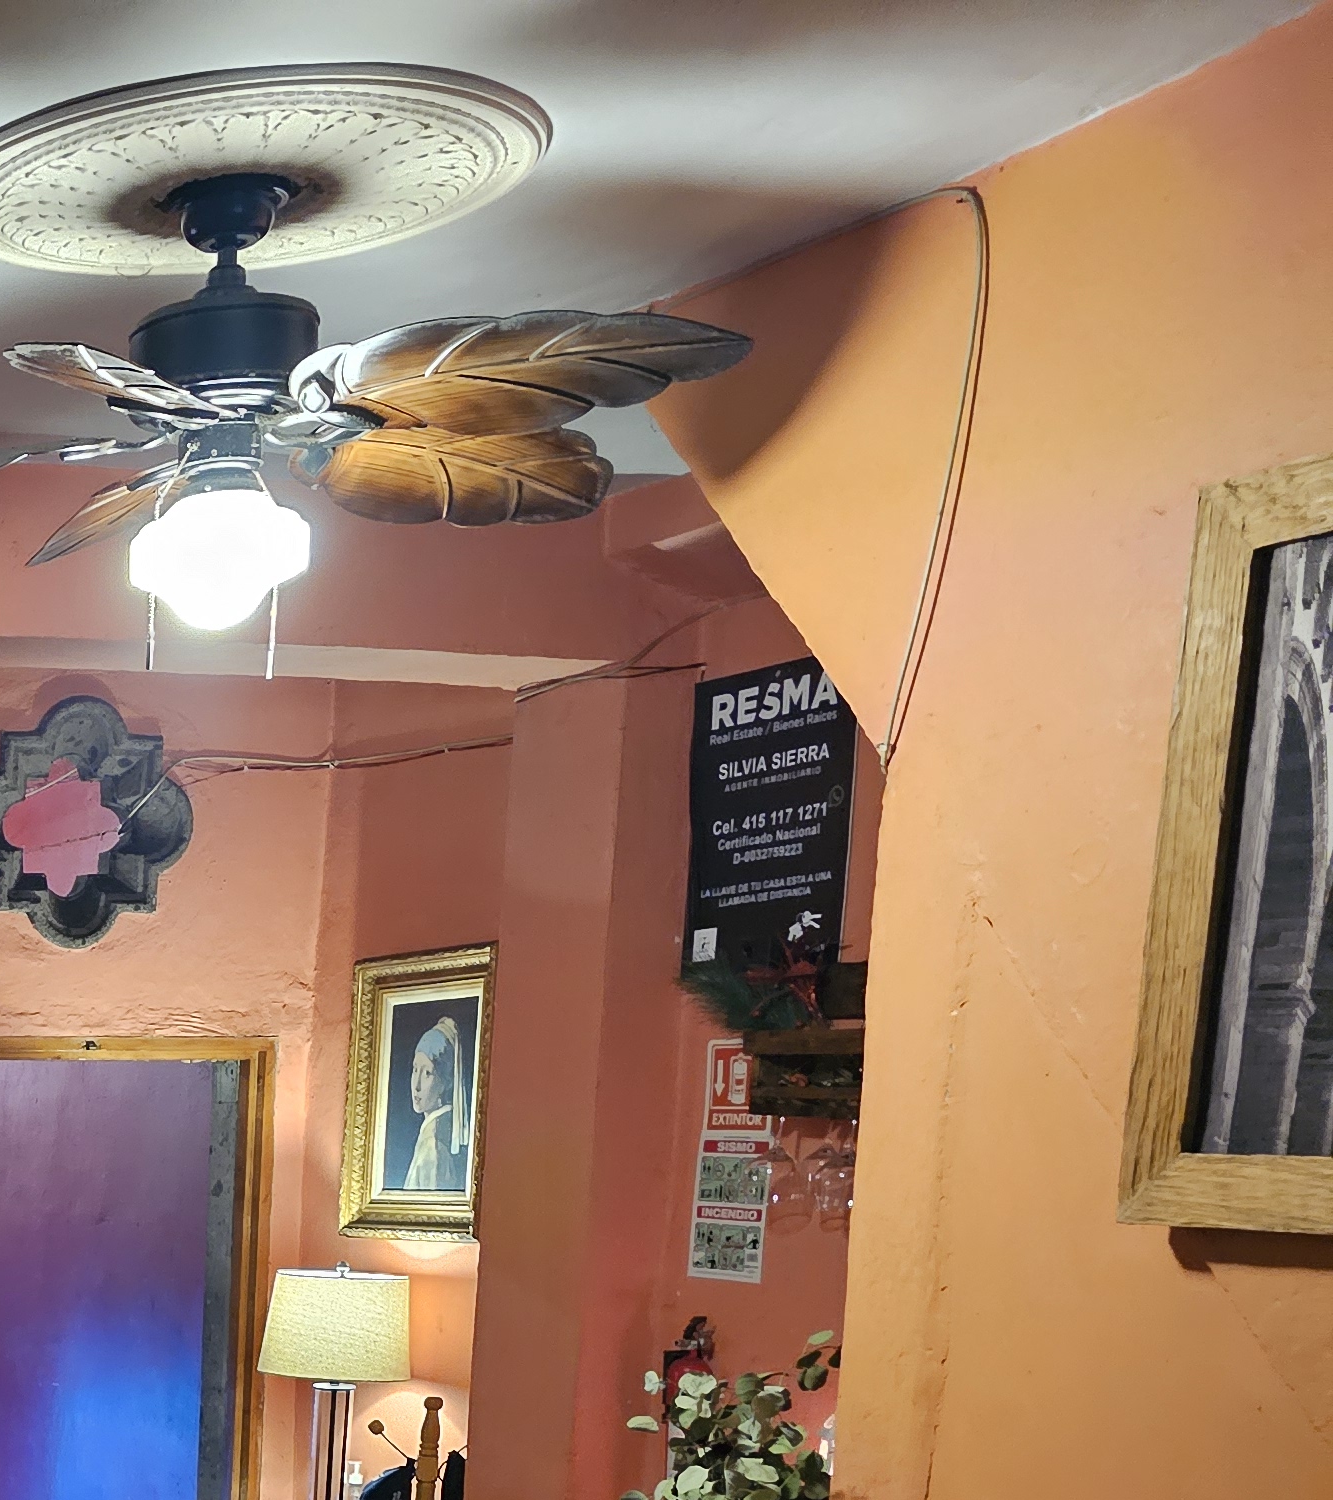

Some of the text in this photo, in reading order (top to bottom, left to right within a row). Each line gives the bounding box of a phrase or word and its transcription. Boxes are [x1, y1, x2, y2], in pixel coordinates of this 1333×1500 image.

[711, 672, 838, 730] RESMA
[709, 732, 731, 746] Real
[733, 727, 763, 740] Estate
[773, 717, 804, 733] Bienes
[718, 743, 830, 780] SILVIA SIERRA
[724, 766, 821, 792] AGENTE INMOBILIARIO
[713, 802, 827, 835] Cel. 415 117 1271
[718, 823, 821, 851] Certificado Nacional
[700, 889, 711, 898] LA
[712, 885, 736, 897] LLAVE
[738, 883, 748, 893] DE
[751, 882, 761, 891] TU
[763, 878, 785, 889] CASA
[806, 873, 814, 883] A
[815, 871, 832, 881] UNA
[718, 886, 811, 908] LLAMADA DE DISTANCIA
[712, 1113, 763, 1126] EXTINTOR
[717, 1141, 756, 1153] SISMO
[701, 1207, 758, 1221] INCENDIO
